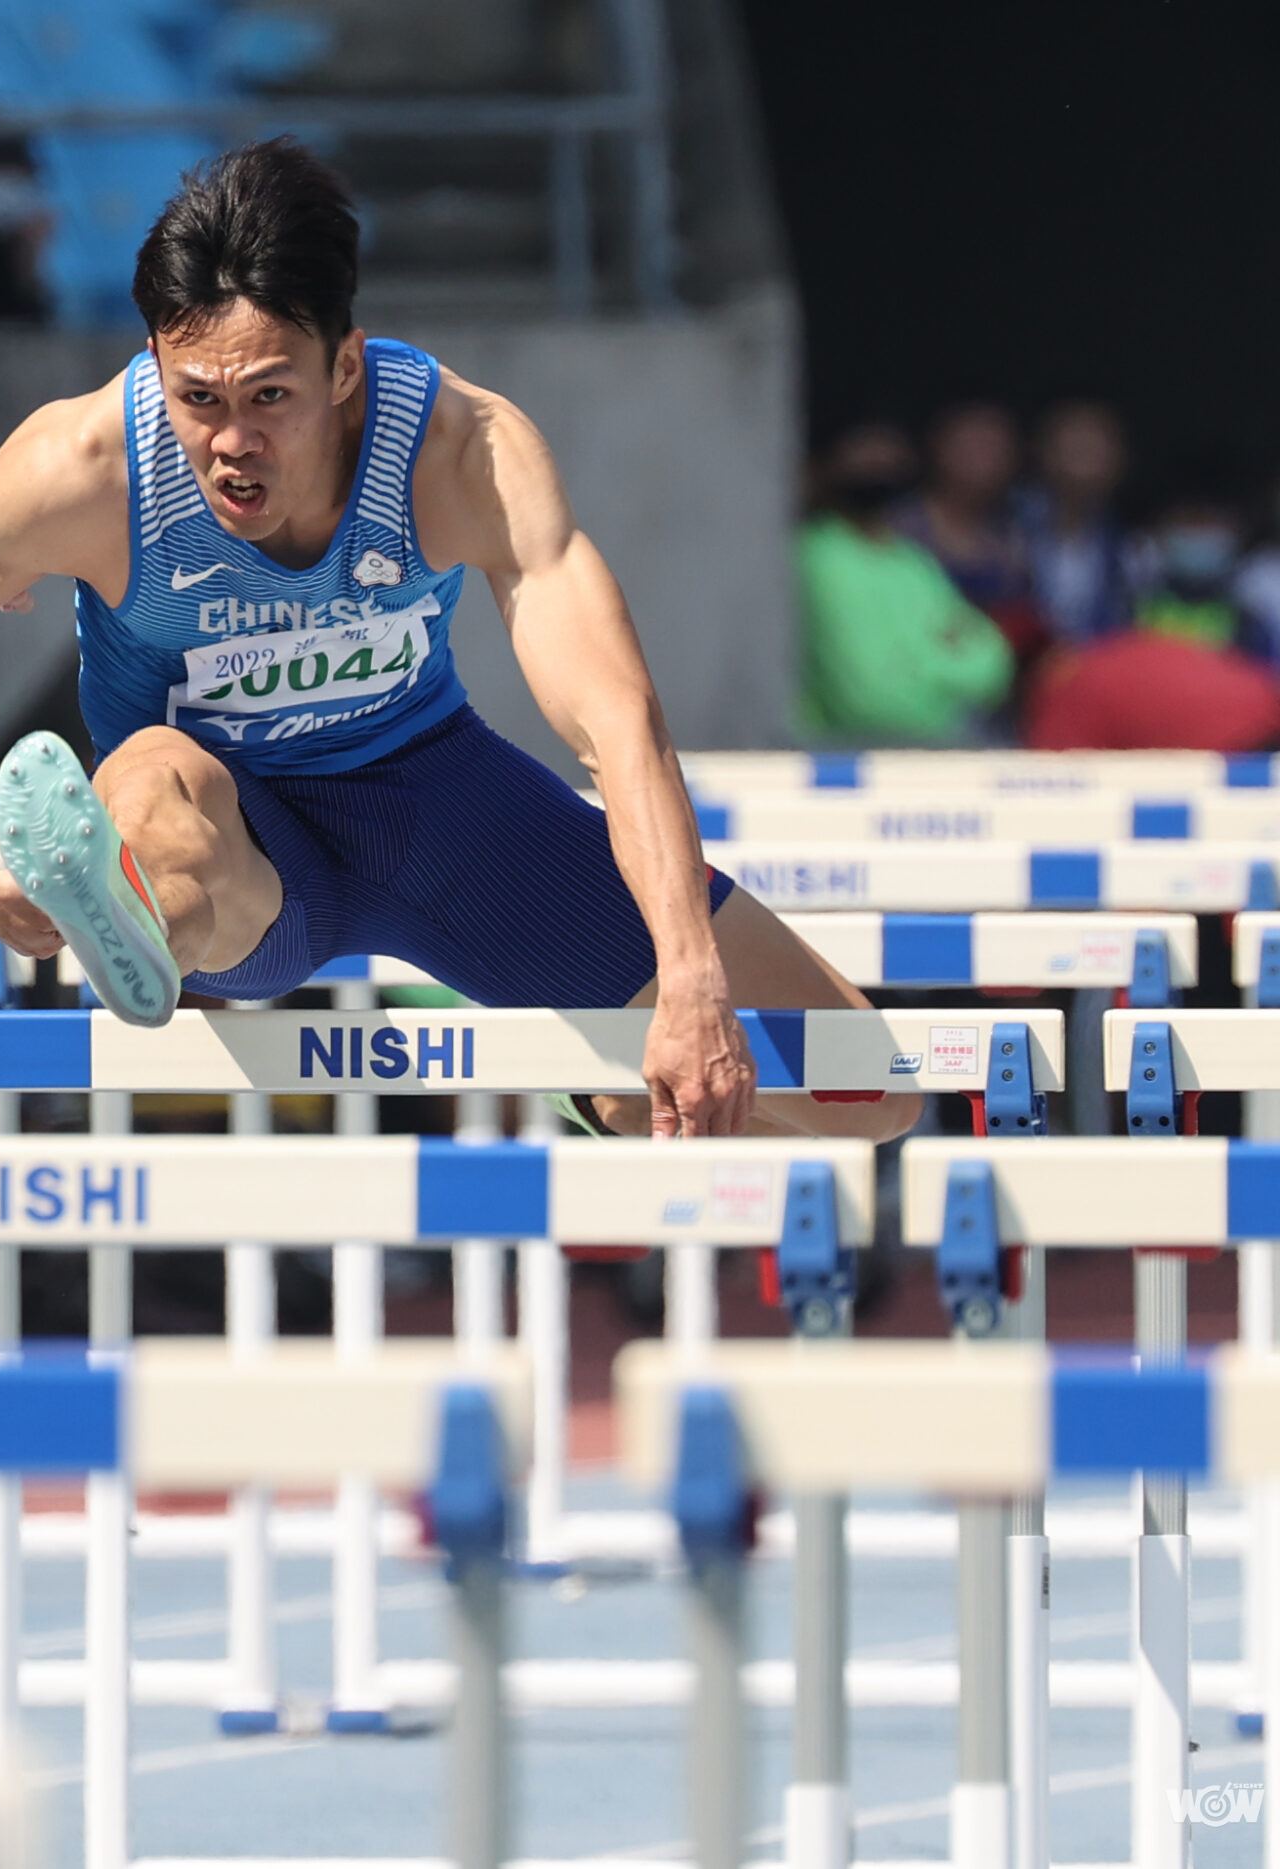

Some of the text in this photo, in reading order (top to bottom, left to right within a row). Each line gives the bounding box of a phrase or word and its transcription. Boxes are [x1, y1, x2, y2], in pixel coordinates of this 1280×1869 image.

[202, 630, 418, 701] 0044
[215, 649, 276, 679] 2022
[300, 1026, 475, 1079] NISHI
